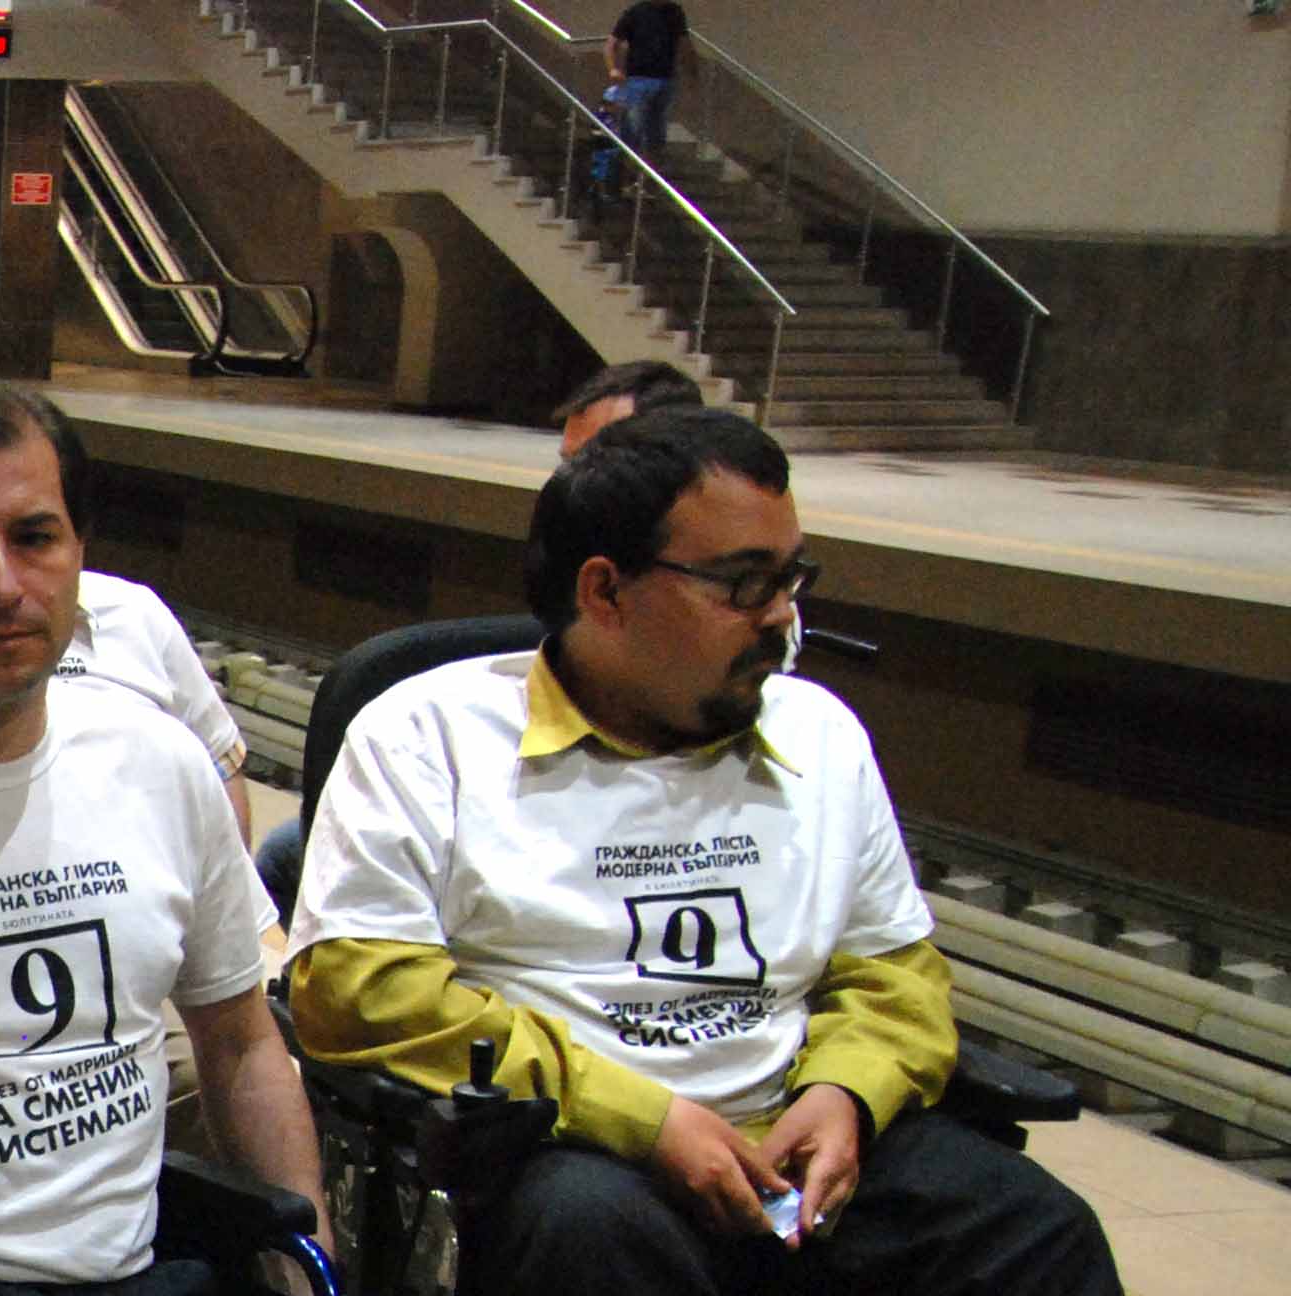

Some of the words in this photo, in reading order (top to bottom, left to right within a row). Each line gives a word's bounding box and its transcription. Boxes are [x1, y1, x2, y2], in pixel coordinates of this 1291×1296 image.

[596, 841, 708, 861] ГРАЖДАНСКА
[63, 860, 124, 881] ЛИСТА
[596, 862, 679, 880] МОДЕРНА
[33, 878, 129, 907] БЪЛГАРИЯ
[10, 947, 75, 1054] 9
[23, 1057, 145, 1122] СМЕНИМ
[25, 1074, 46, 1092] ОТ
